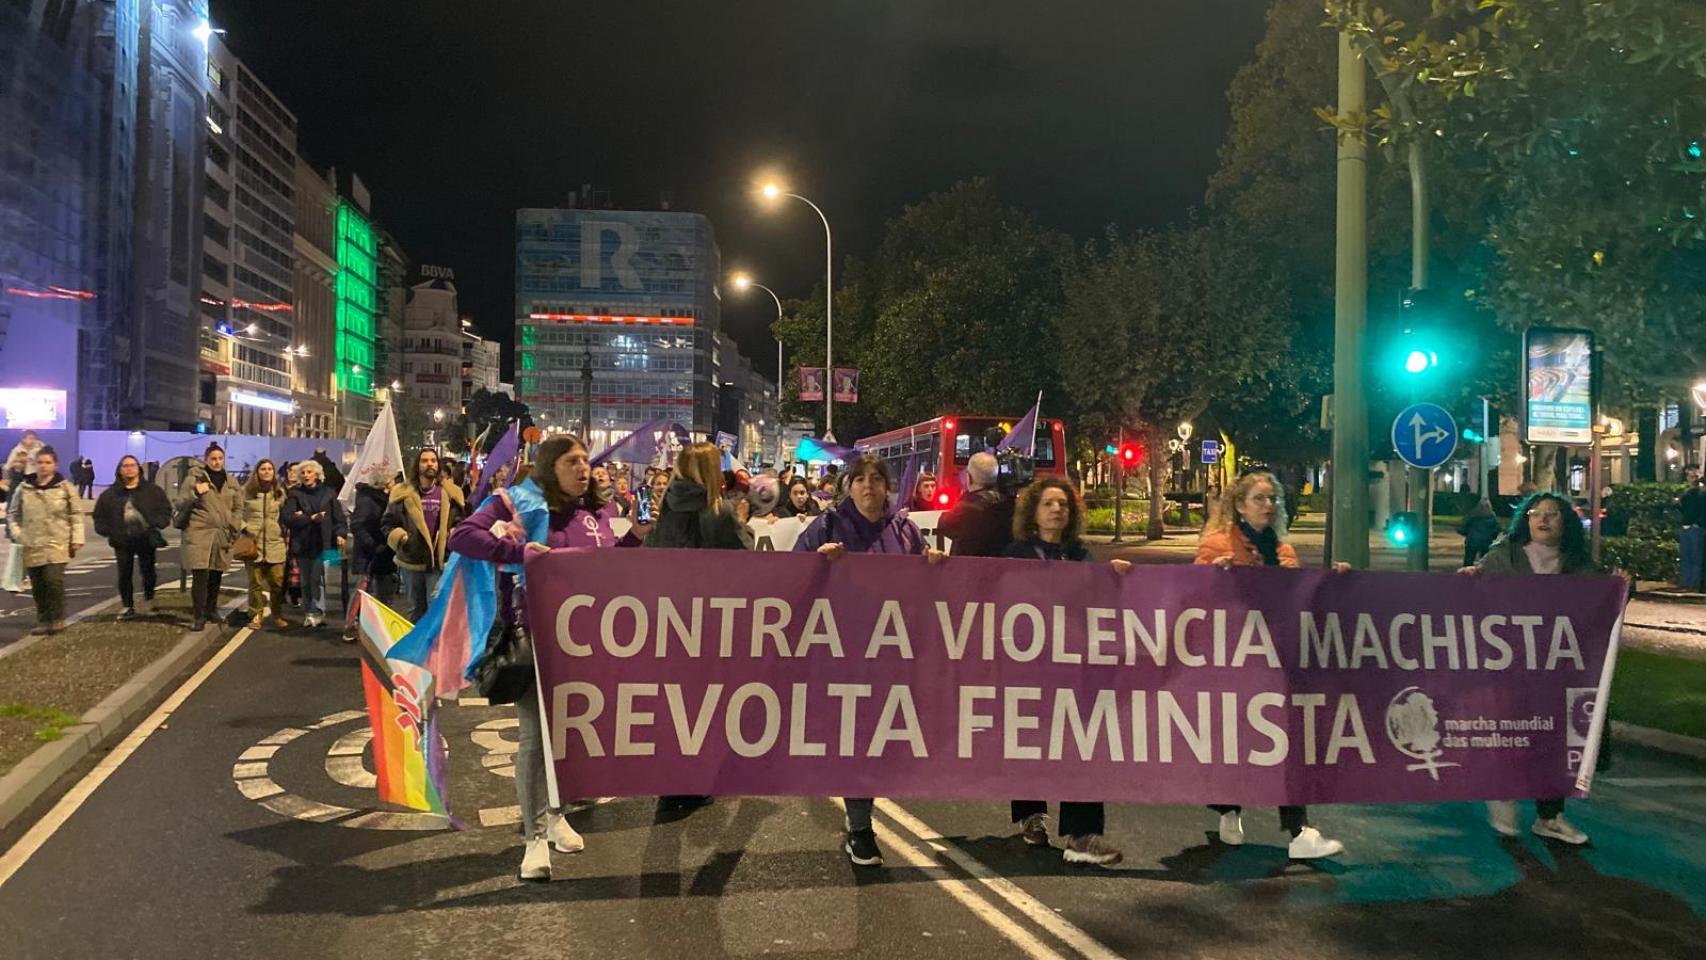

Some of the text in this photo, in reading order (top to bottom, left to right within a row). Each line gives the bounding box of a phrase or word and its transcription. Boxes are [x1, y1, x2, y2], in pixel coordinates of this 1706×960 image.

[420, 264, 455, 279] BBVA
[556, 595, 1585, 671] CONTRA A VIOLENCIA MACHISTA
[552, 682, 928, 760] REVOLTA
[958, 686, 1376, 766] FEMINISTA
[1445, 716, 1554, 731] marcha mundial
[1443, 732, 1530, 748] das mulleres
